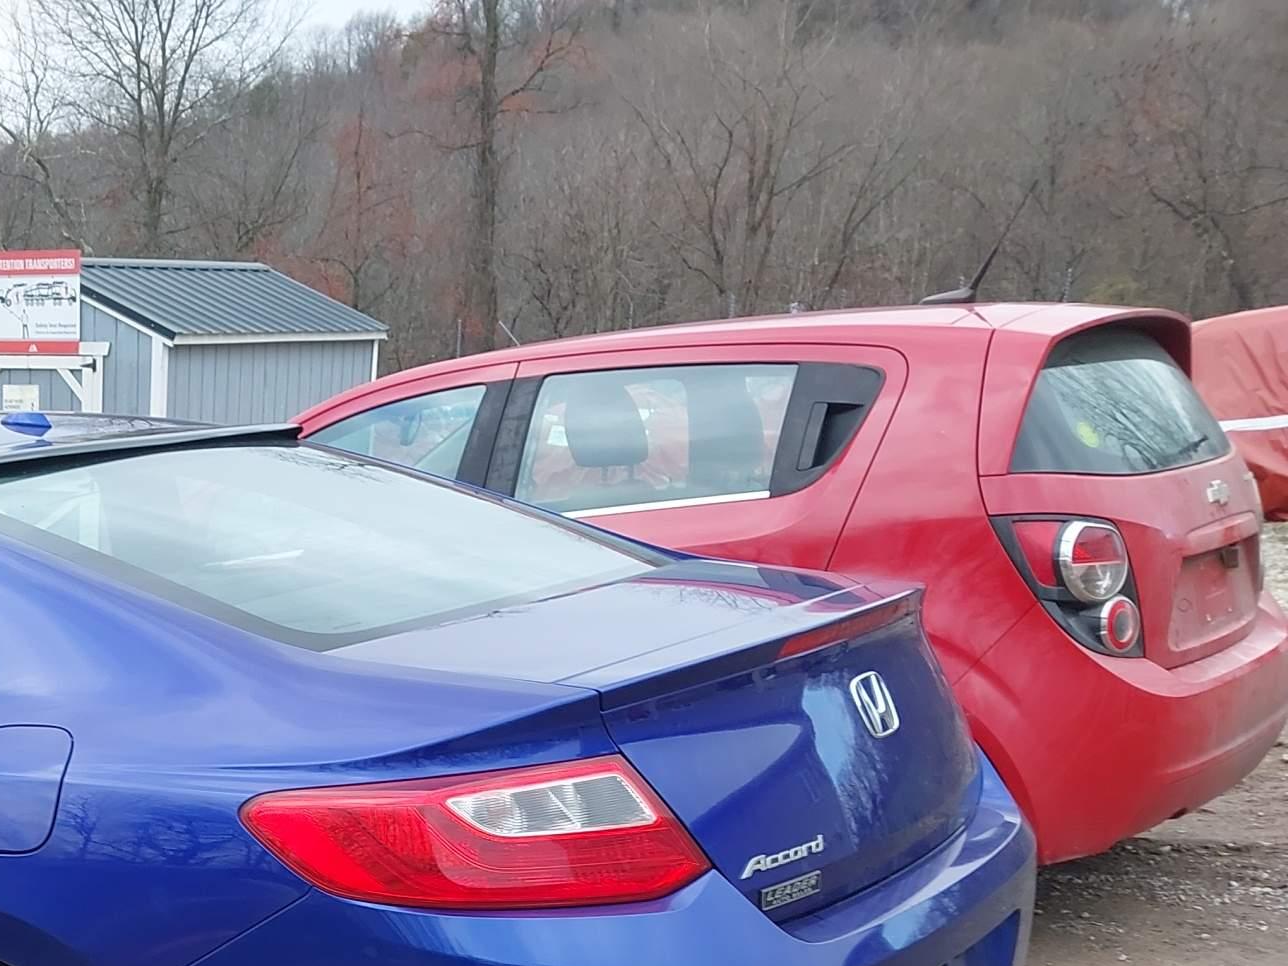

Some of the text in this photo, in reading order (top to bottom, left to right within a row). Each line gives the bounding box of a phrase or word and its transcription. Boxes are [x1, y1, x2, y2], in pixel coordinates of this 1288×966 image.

[25, 258, 75, 270] TRANSPORTERS
[740, 834, 825, 880] Accord
[766, 875, 818, 901] LEADER
